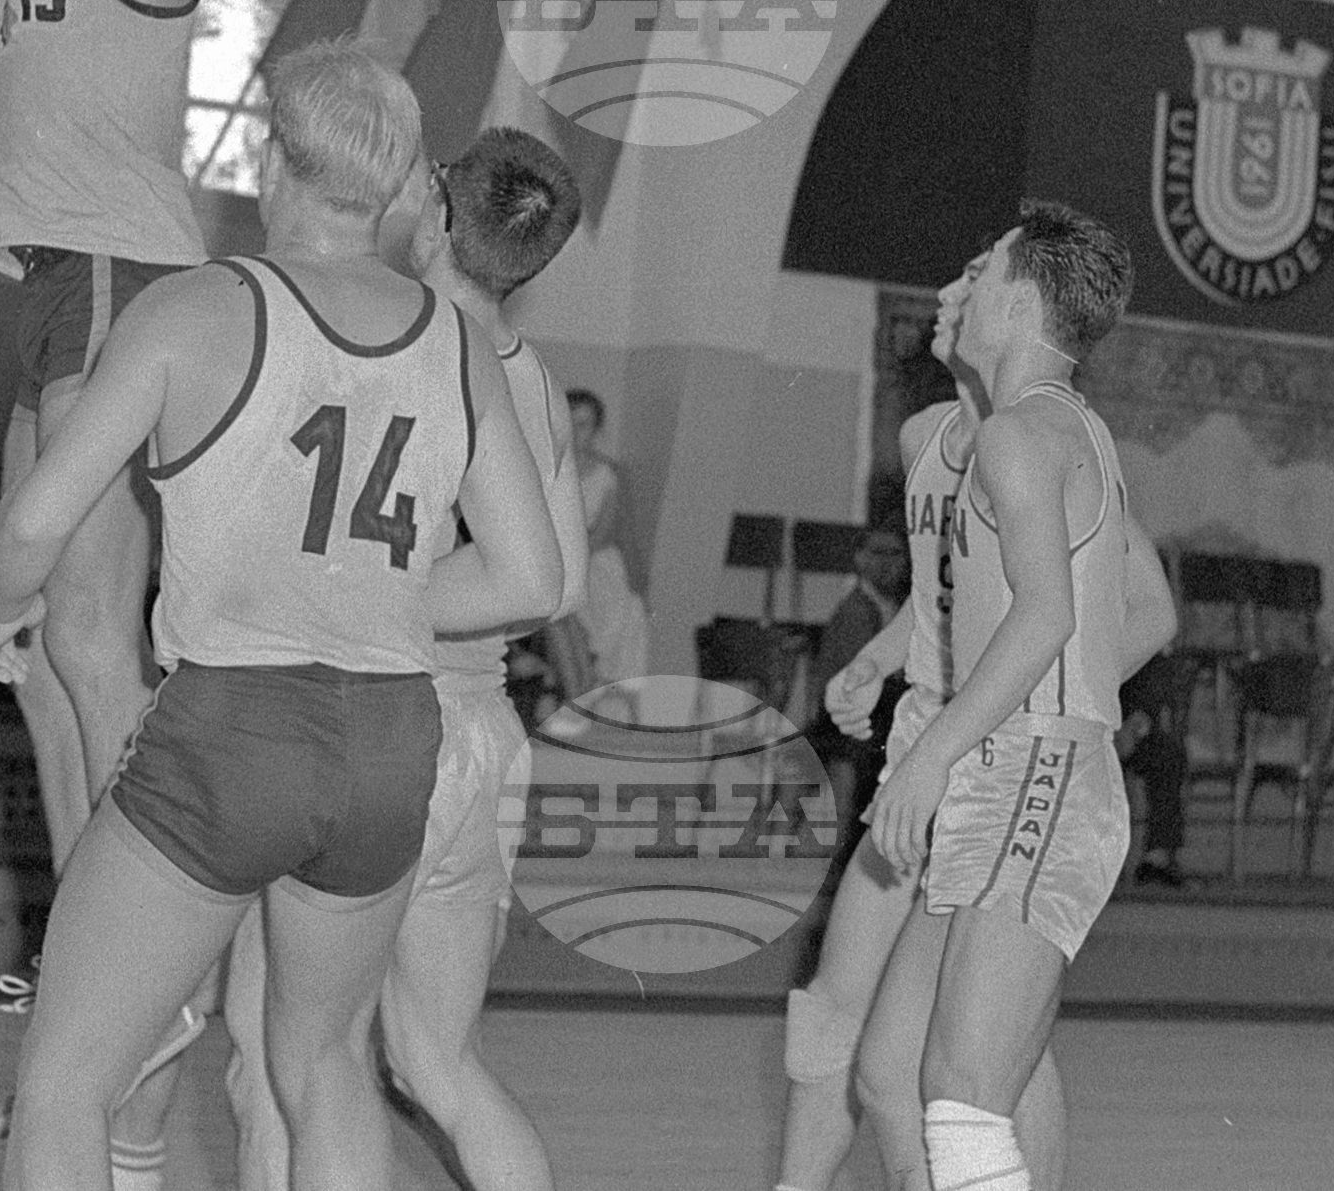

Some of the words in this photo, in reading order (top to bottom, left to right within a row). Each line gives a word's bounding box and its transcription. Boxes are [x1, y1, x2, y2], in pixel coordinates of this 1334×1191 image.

[1210, 68, 1314, 110] SOFIA
[1168, 108, 1321, 297] UNIVERSIADE
[289, 404, 418, 571] 14
[980, 736, 995, 767] 6
[1009, 753, 1062, 860] JAPAN
